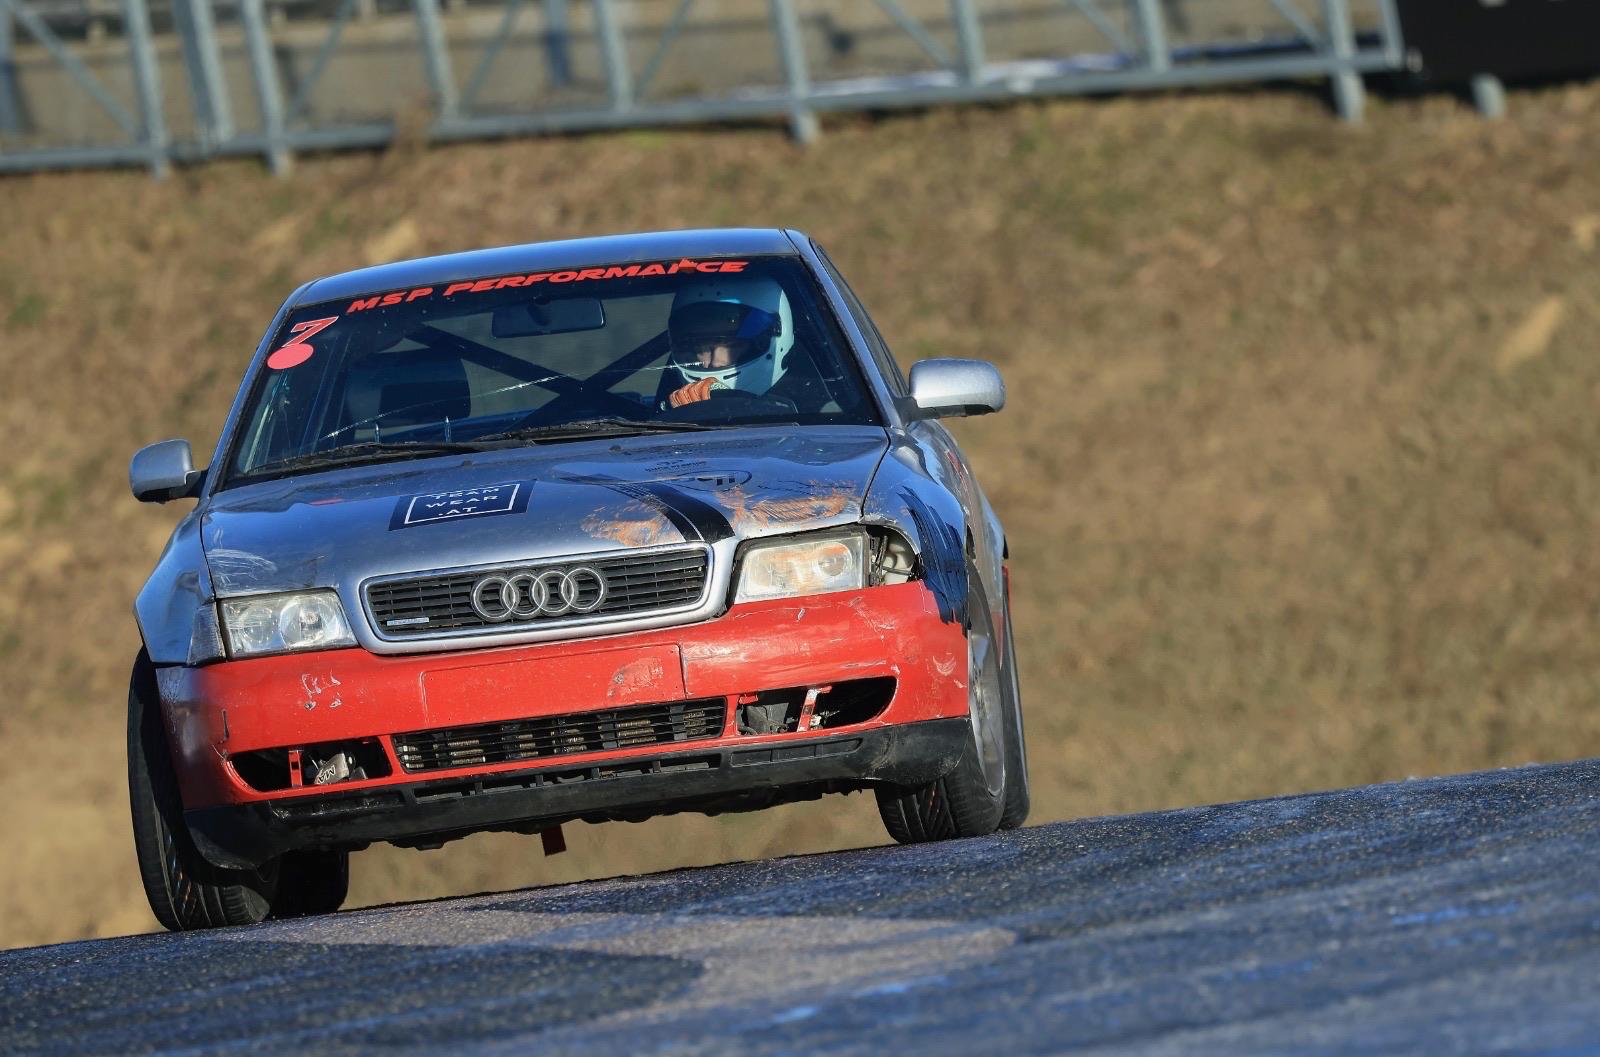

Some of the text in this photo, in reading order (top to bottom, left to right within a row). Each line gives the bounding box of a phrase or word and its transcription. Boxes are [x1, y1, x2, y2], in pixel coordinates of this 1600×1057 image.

[346, 287, 434, 313] MSP
[281, 316, 339, 347] 7
[426, 495, 499, 508] WEAR
[317, 764, 336, 784] MA
